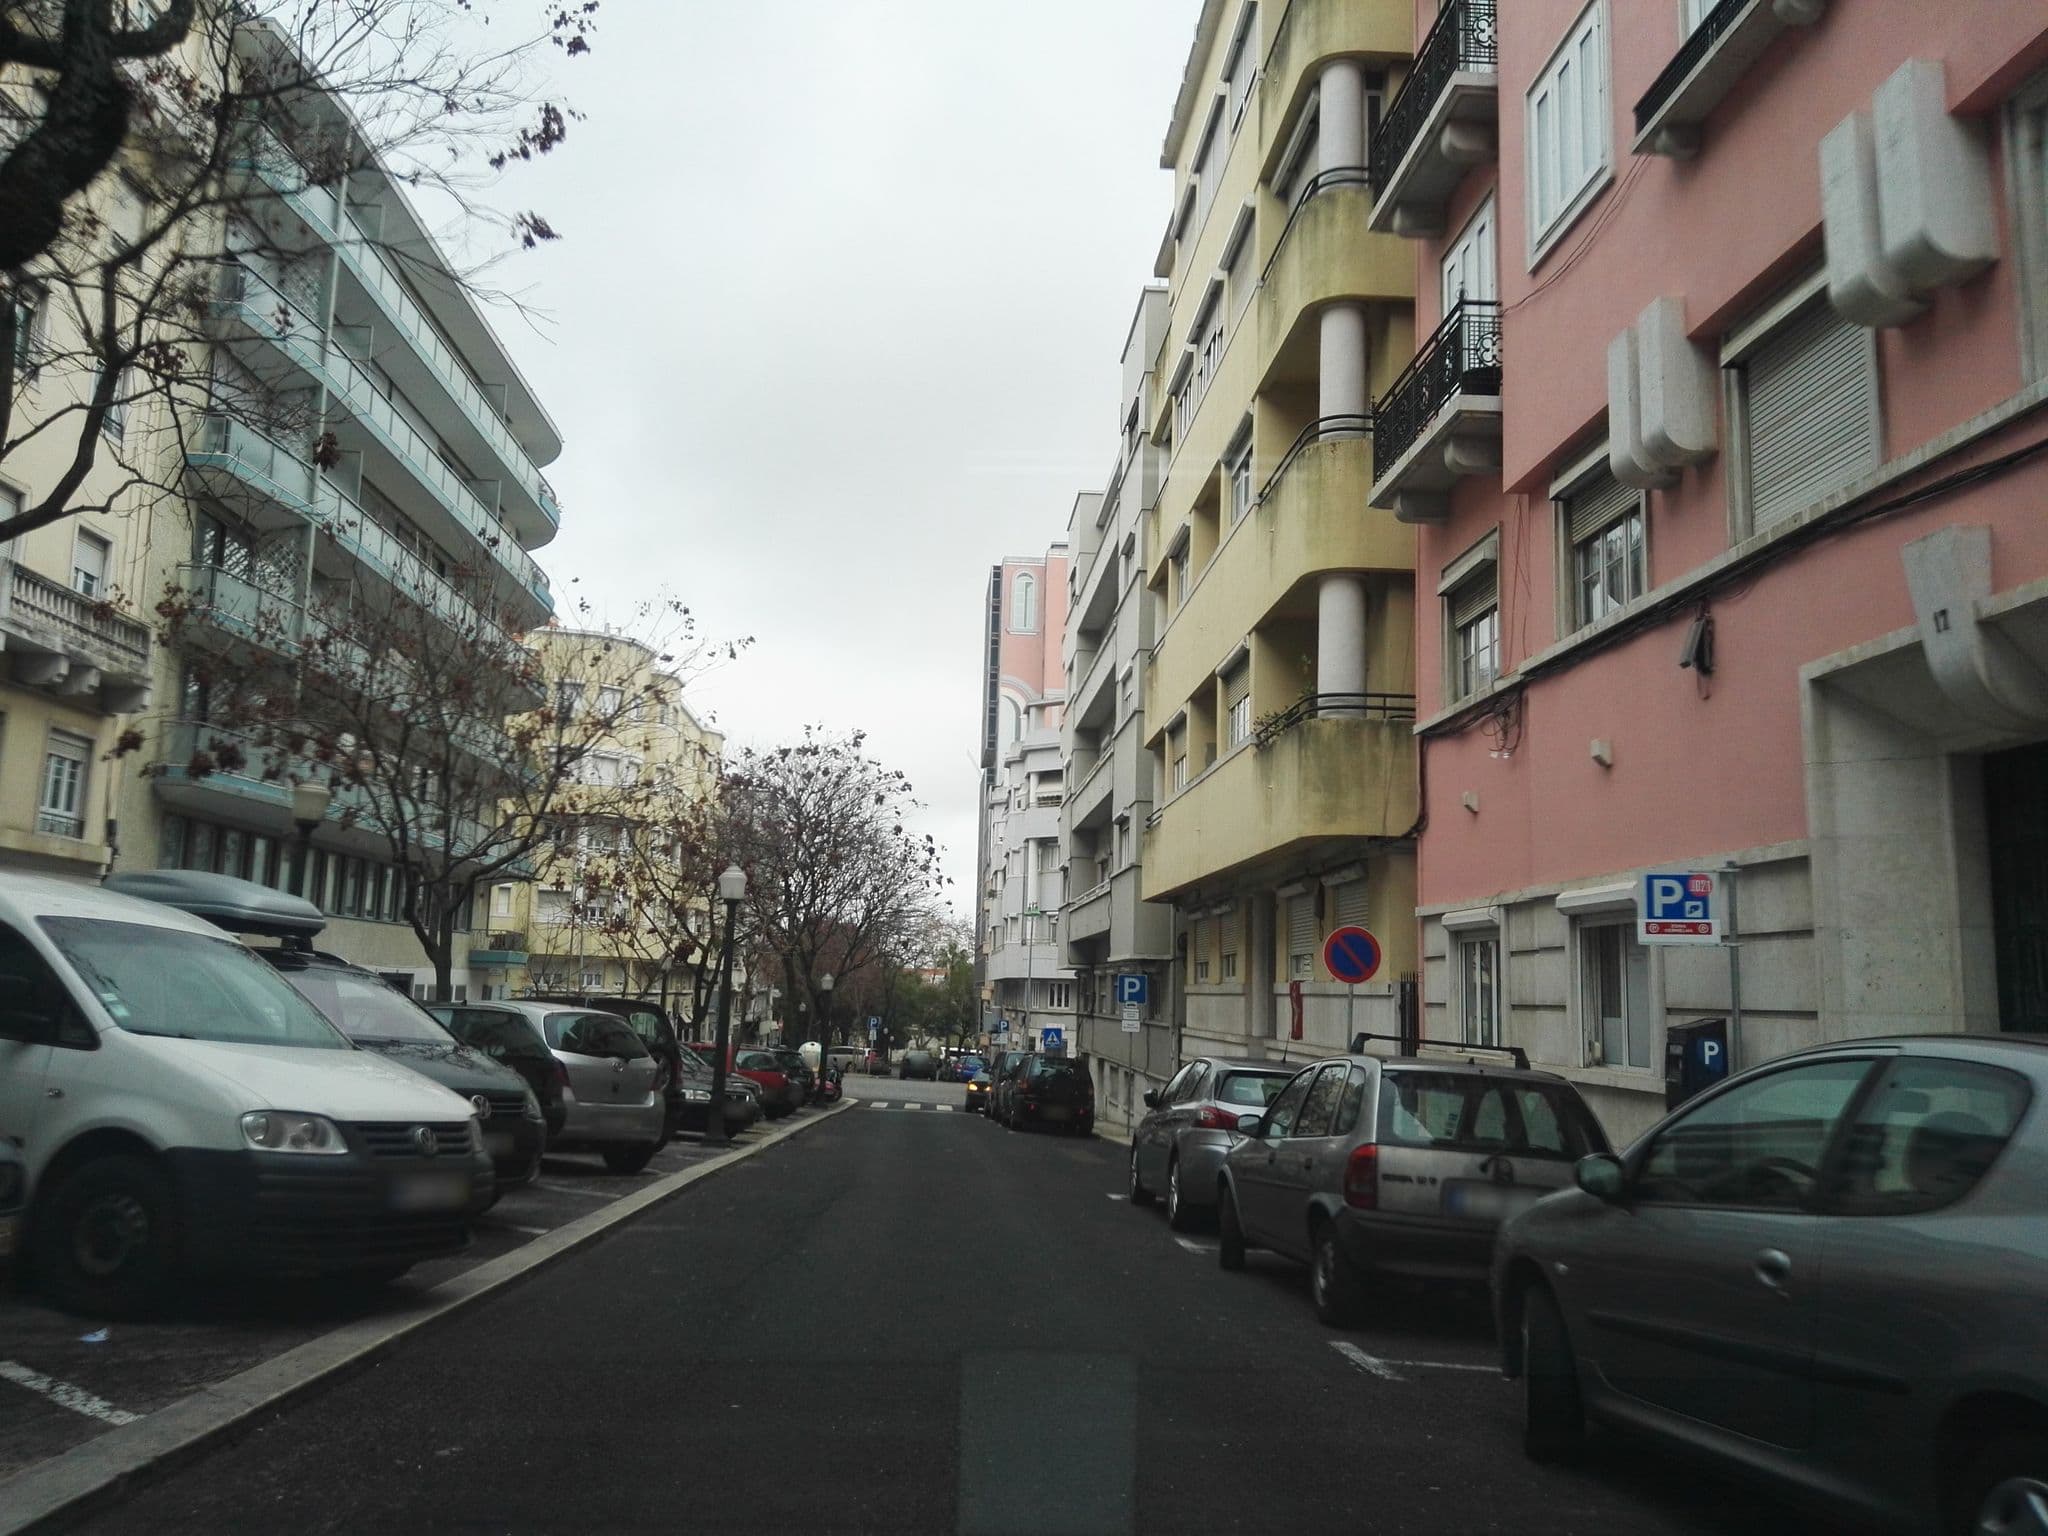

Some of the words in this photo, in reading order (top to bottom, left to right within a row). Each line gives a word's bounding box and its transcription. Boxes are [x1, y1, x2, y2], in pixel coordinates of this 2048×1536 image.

[1653, 879, 1684, 917] P
[1124, 977, 1140, 1000] P
[1000, 1021, 1008, 1032] P
[1704, 1041, 1719, 1064] P
